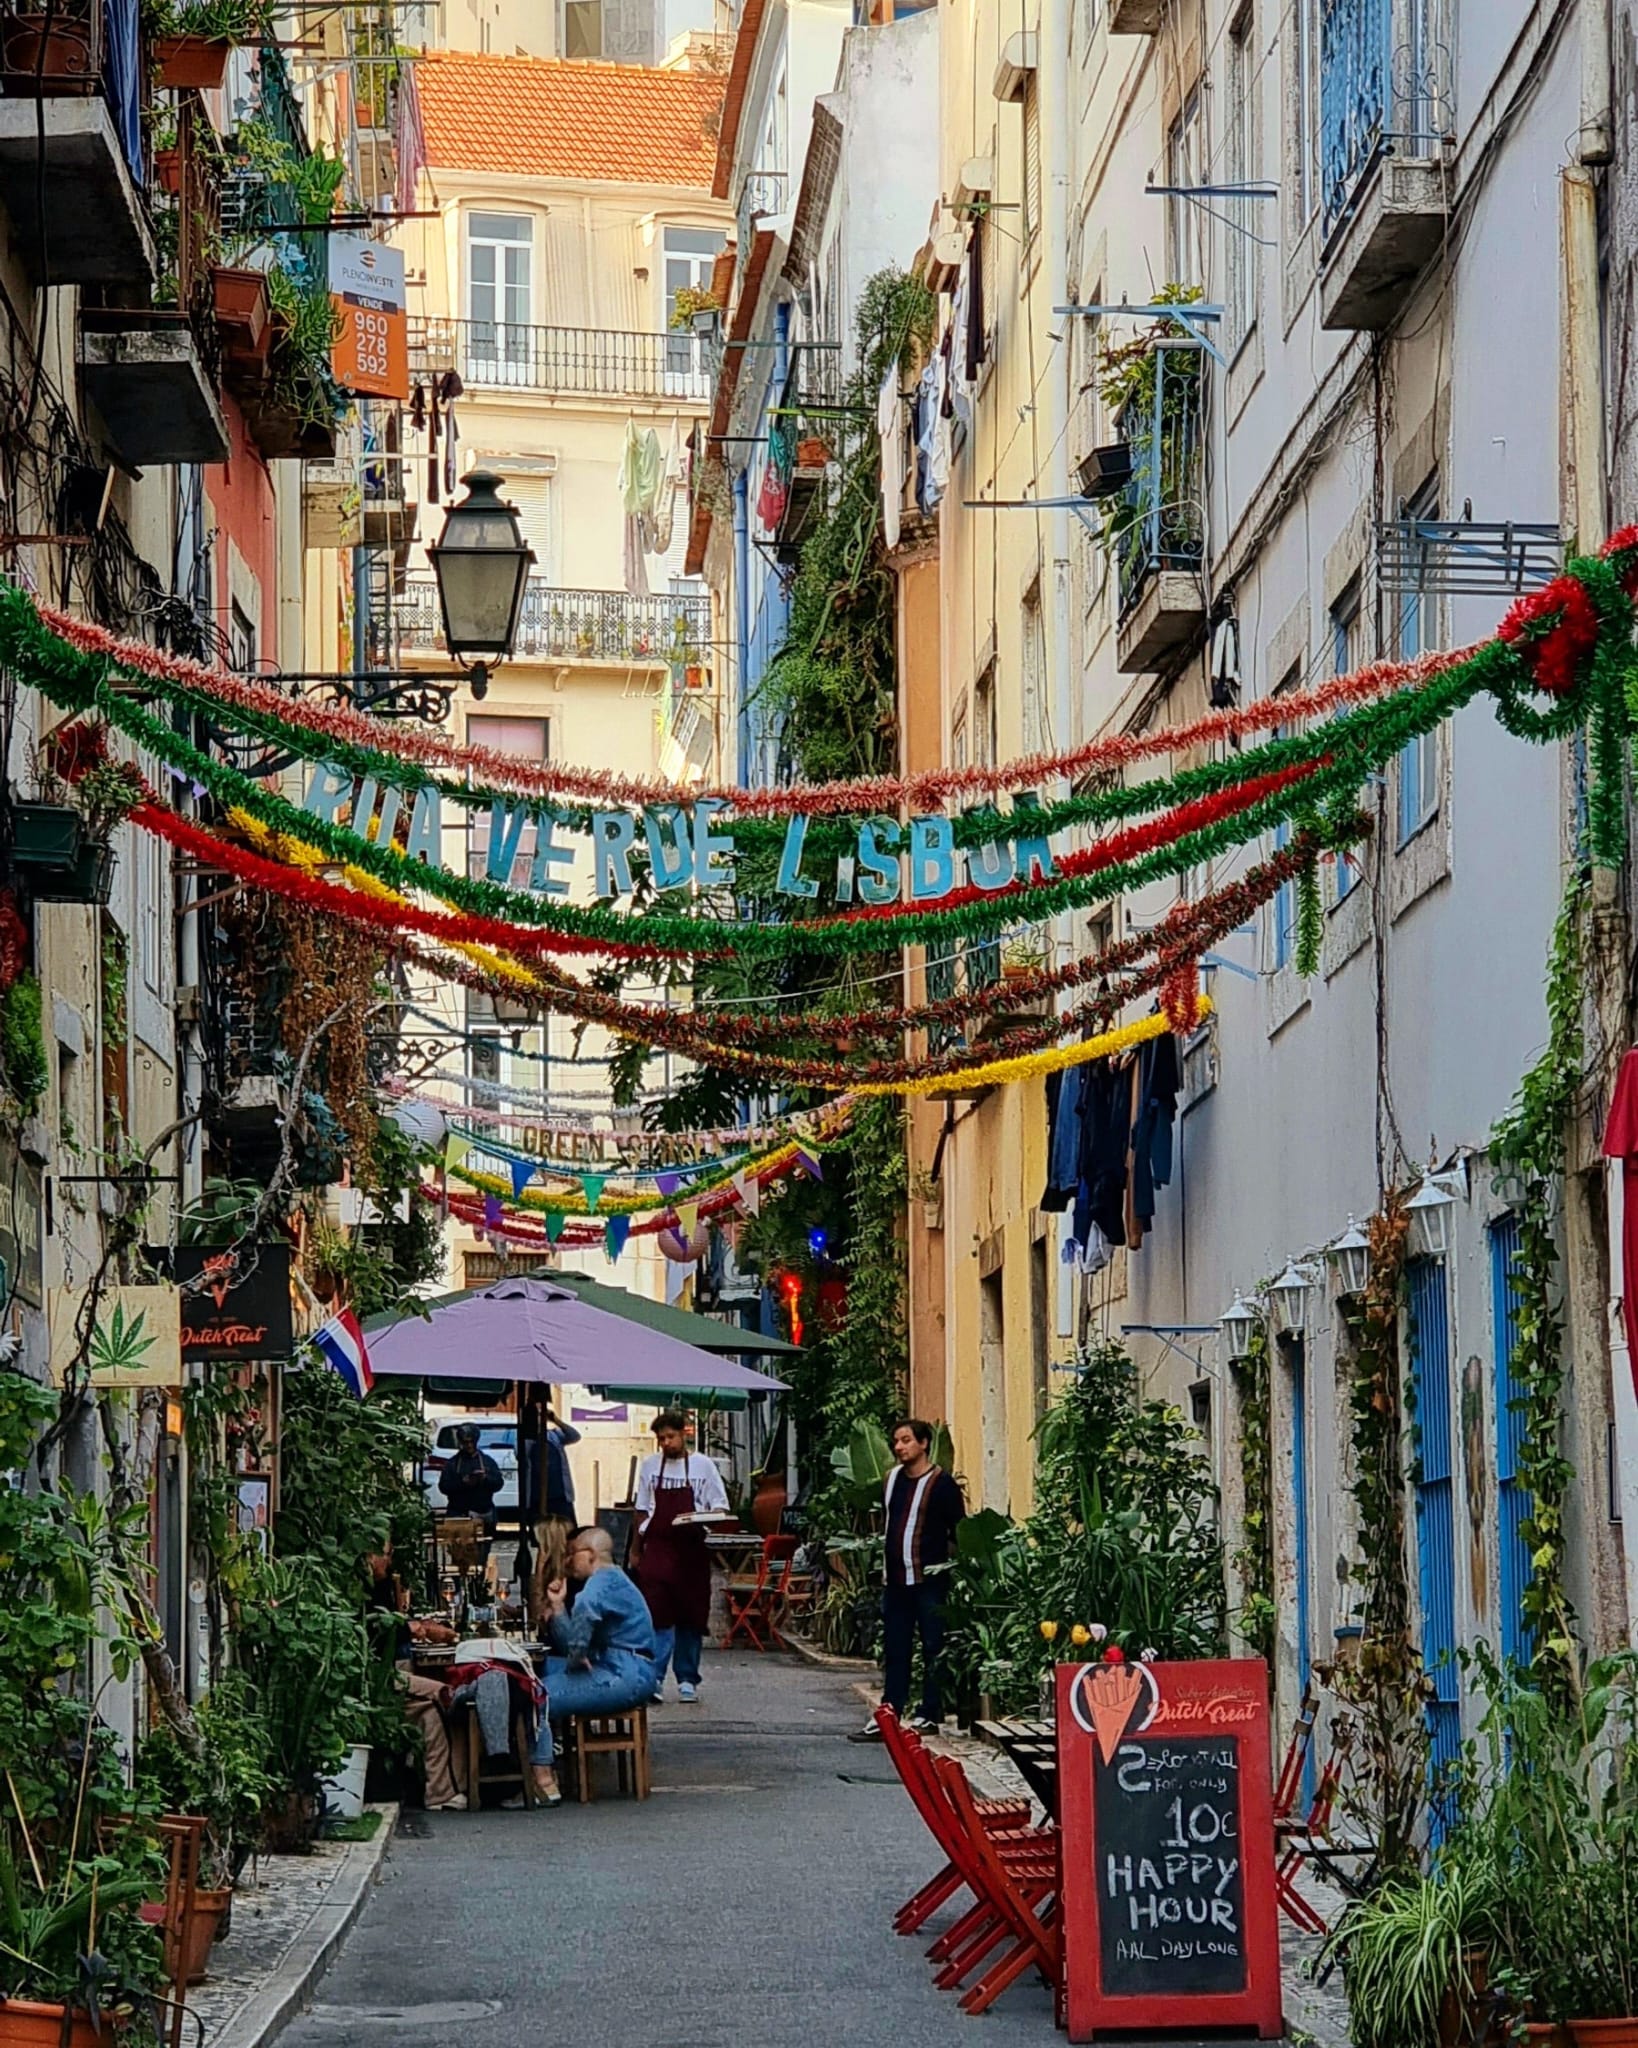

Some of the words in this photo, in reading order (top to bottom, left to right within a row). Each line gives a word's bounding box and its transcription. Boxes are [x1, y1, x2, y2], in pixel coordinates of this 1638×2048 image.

[357, 296, 385, 312] VENDE
[355, 311, 388, 336] 960
[356, 332, 388, 357] 278
[357, 352, 388, 377] 592
[486, 797, 737, 897] VERDE
[523, 1125, 605, 1163] GREEN
[221, 1324, 268, 1347] Treat
[1148, 1697, 1204, 1724] Dutch
[1202, 1694, 1261, 1724] Treat
[1117, 1743, 1152, 1793] 2
[1107, 1853, 1239, 1898] HAPPY
[1128, 1893, 1238, 1934] HOUR
